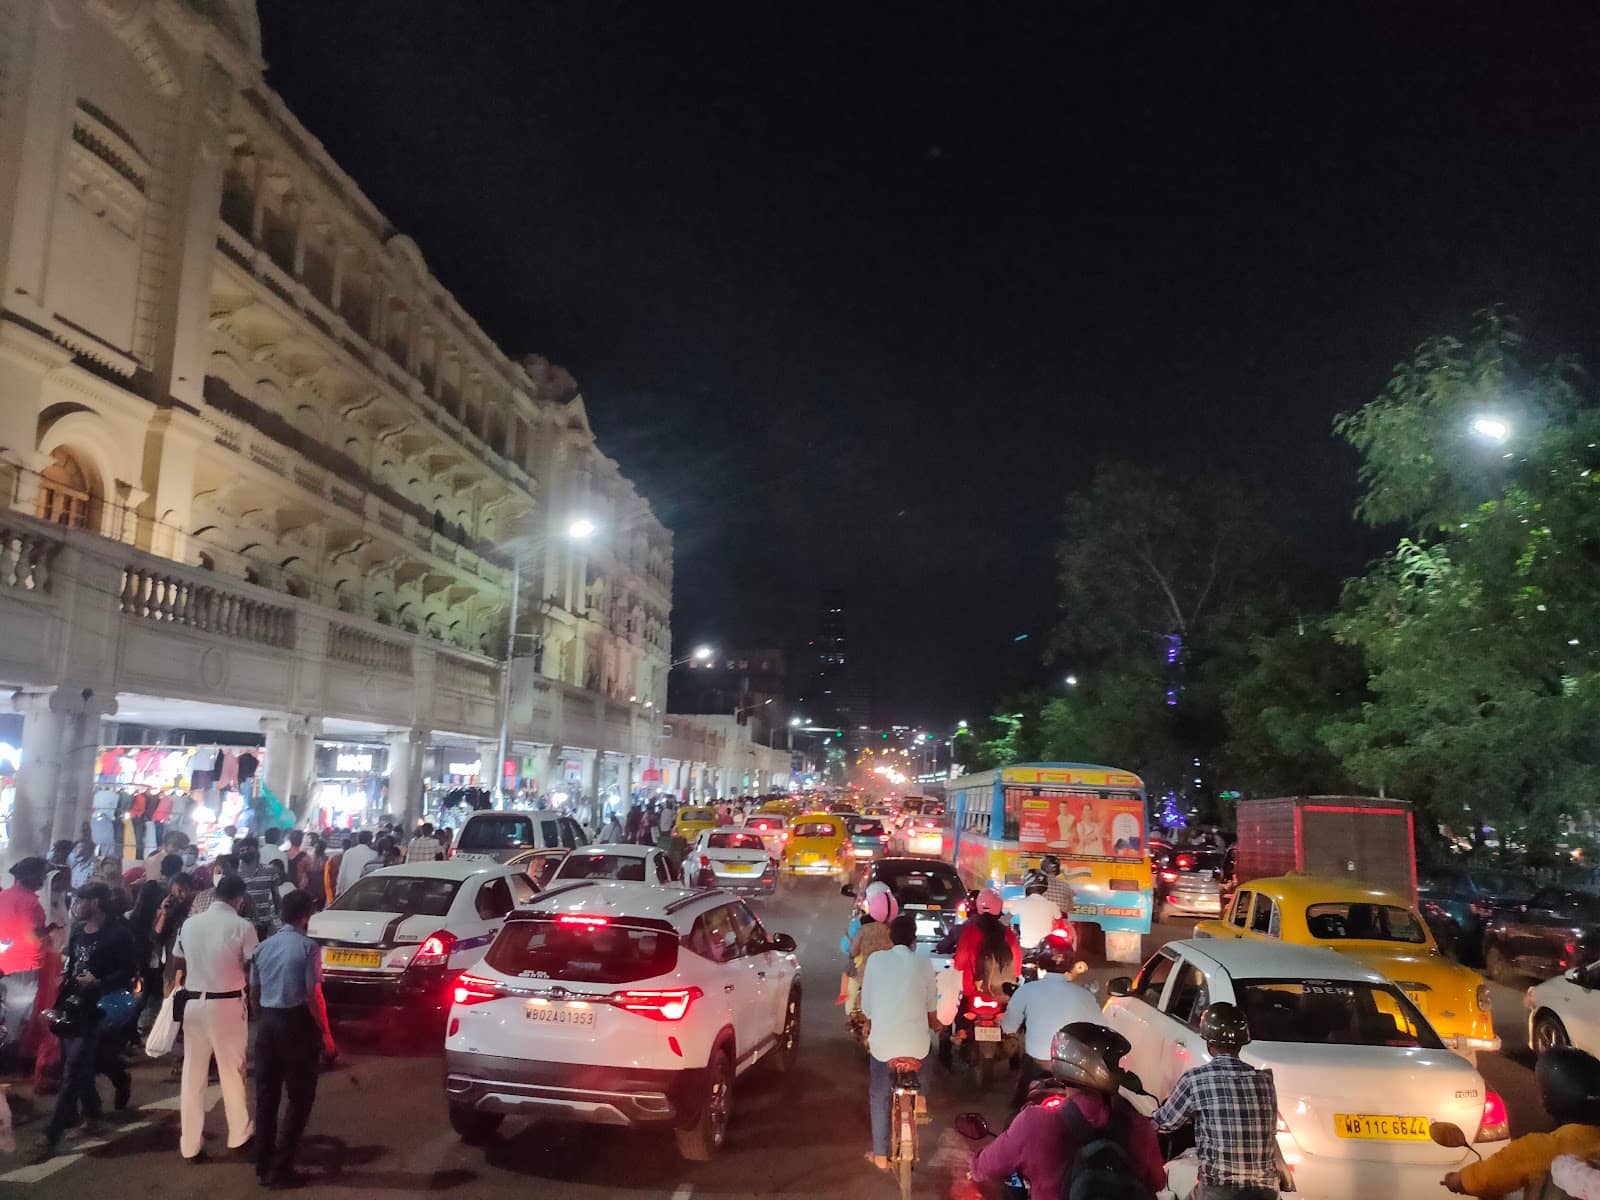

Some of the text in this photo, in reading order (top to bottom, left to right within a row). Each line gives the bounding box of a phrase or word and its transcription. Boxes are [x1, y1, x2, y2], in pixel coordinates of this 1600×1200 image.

[1345, 1120, 1426, 1136] WB 11C 6644
